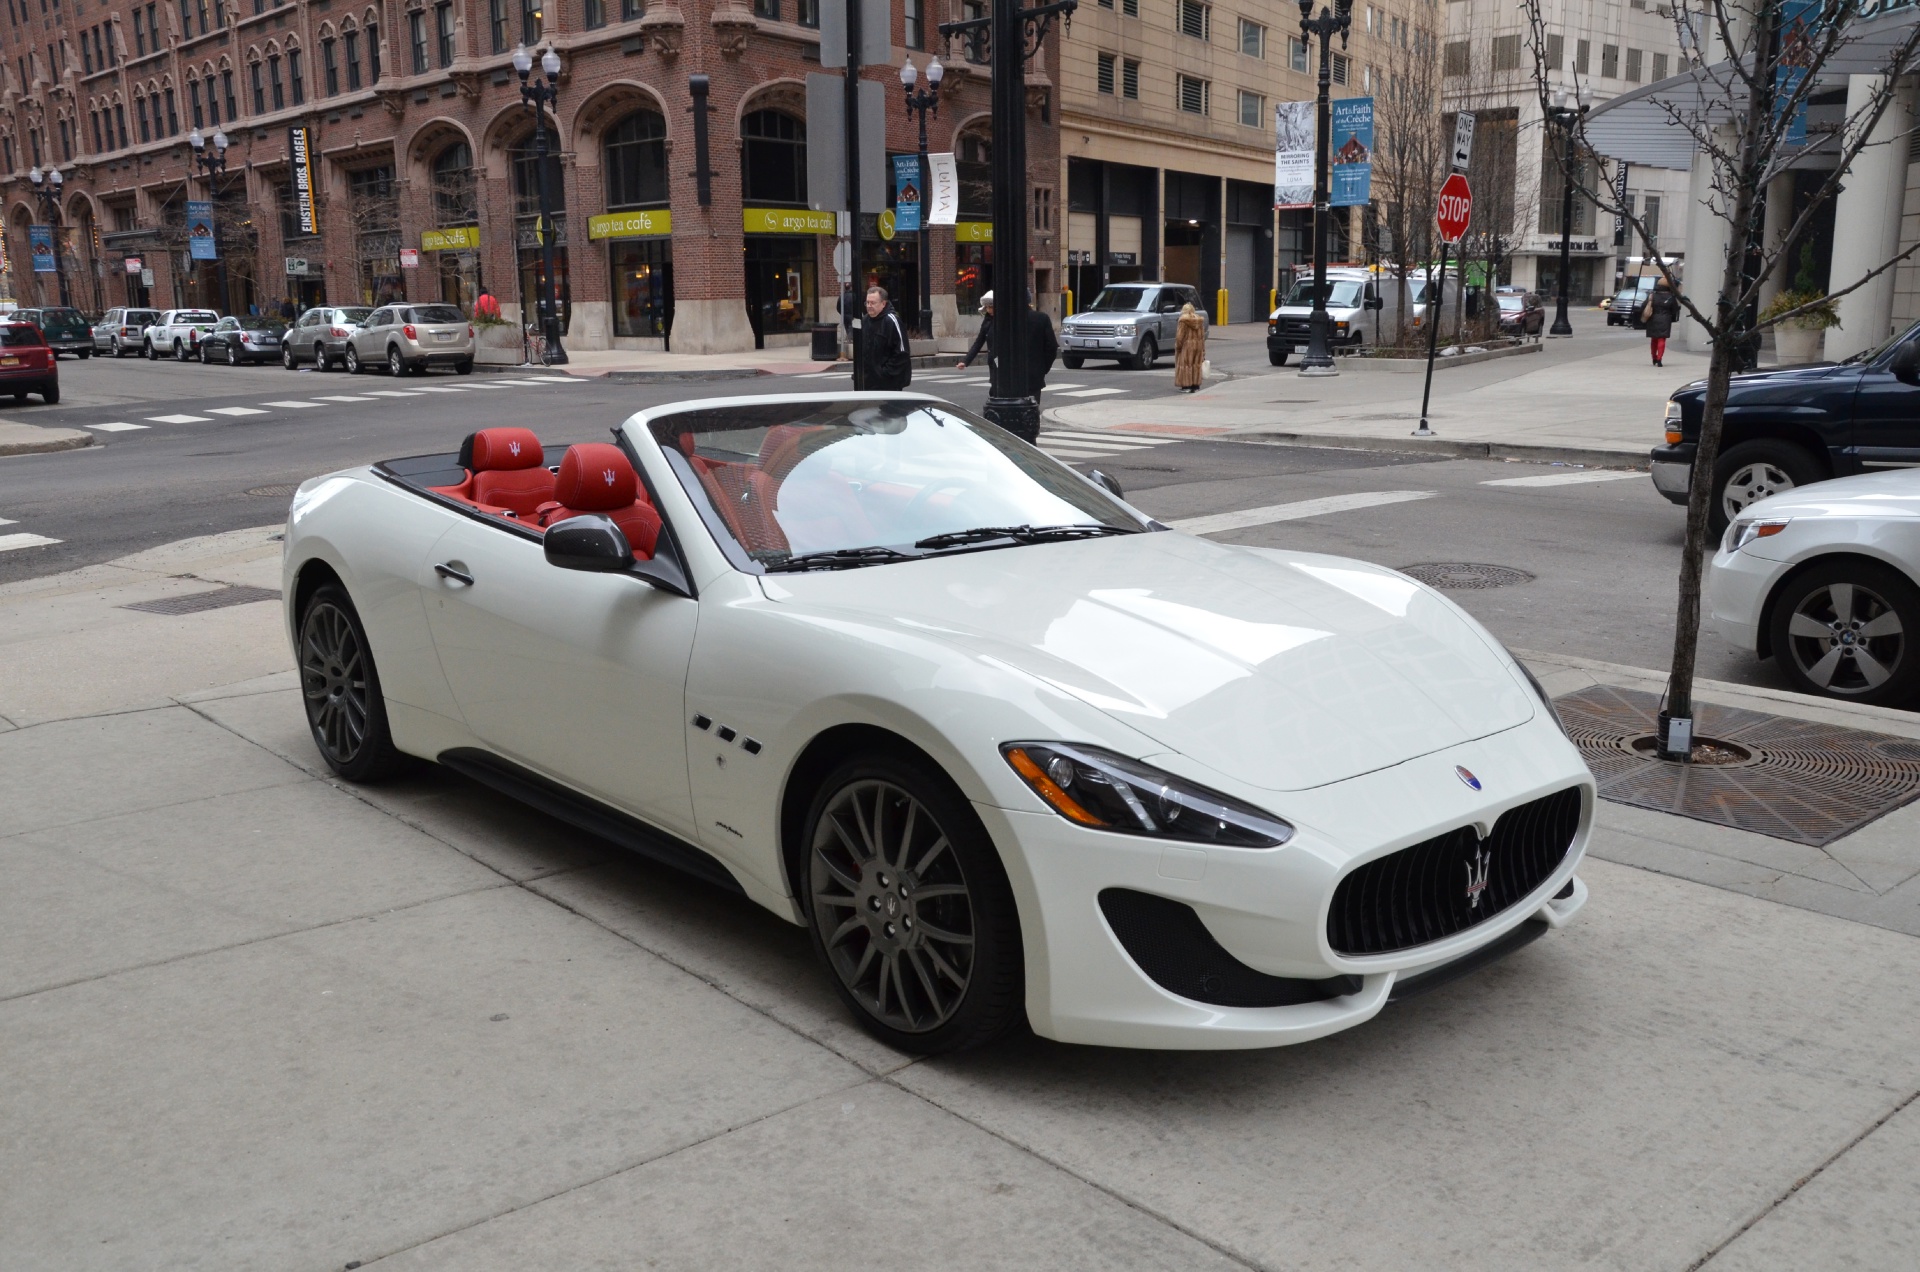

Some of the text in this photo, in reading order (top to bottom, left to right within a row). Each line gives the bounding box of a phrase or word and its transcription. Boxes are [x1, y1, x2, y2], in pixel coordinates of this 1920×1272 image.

[1352, 103, 1371, 115] Faith
[1458, 116, 1473, 132] ONE
[1456, 131, 1471, 147] WAY
[1280, 152, 1310, 160] MIRRORING
[293, 129, 313, 232] EINSTEIN BROS. BAGELS
[1439, 194, 1469, 223] STOP
[596, 212, 652, 236] argo tea café
[783, 212, 832, 231] argo tea café
[434, 235, 444, 246] tea
[445, 229, 466, 245] café
